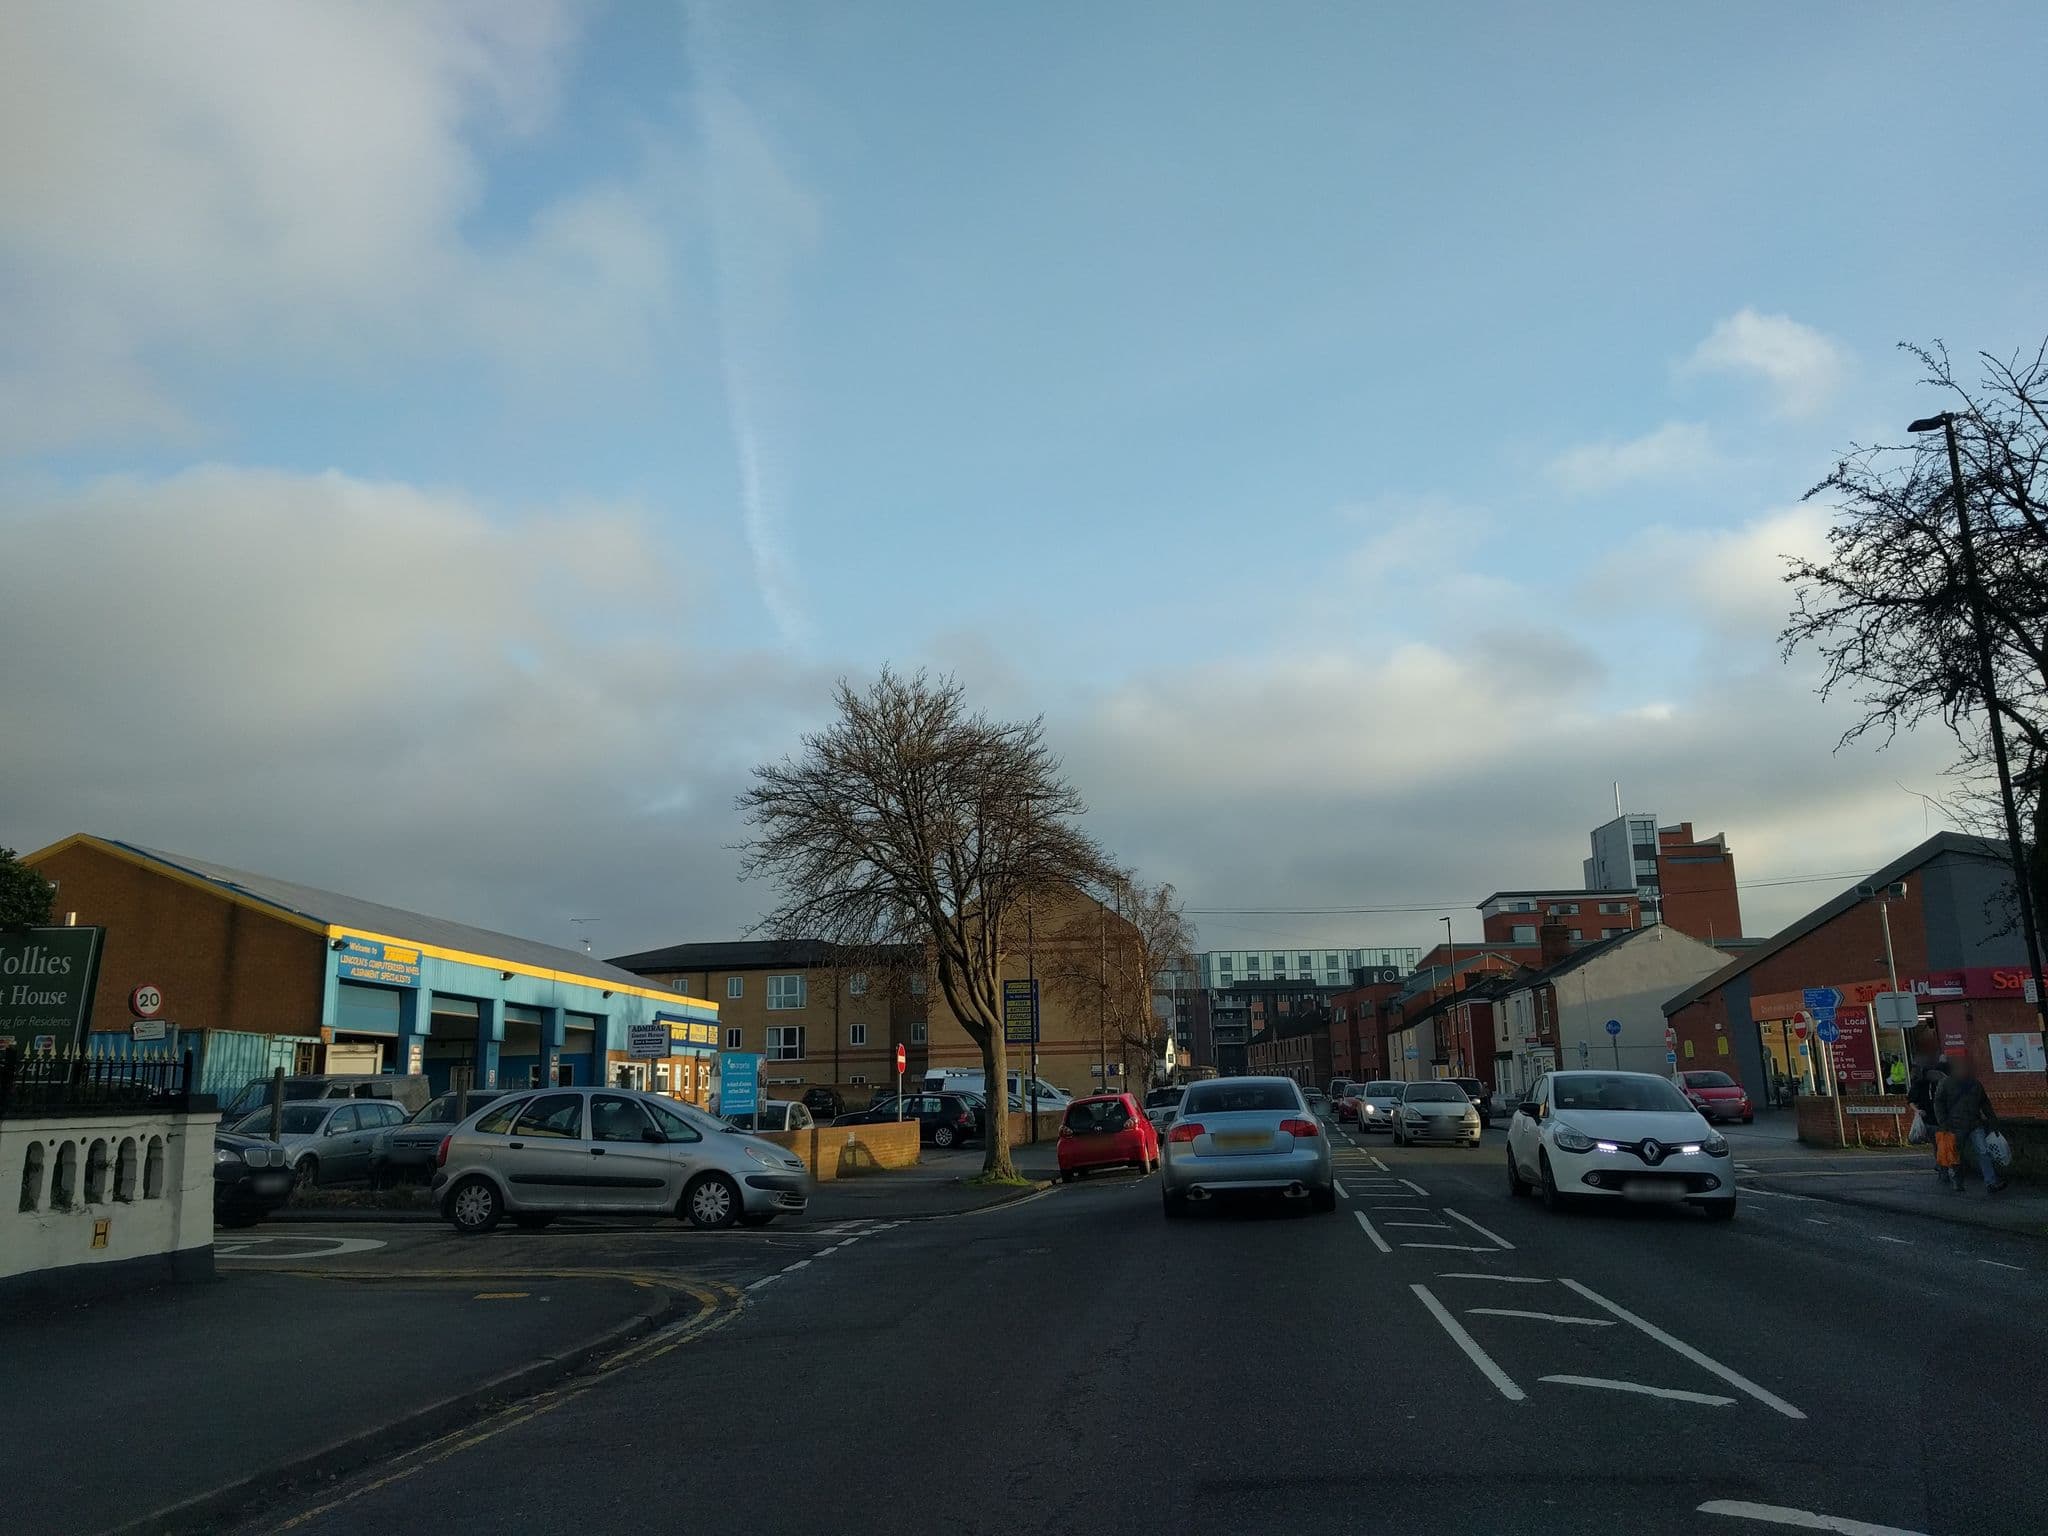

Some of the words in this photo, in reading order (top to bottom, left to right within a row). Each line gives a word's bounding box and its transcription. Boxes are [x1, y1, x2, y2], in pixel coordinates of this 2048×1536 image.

[0, 946, 71, 975] ollies
[11, 985, 68, 1005] House
[139, 993, 160, 1007] 20
[29, 1016, 71, 1026] Residents
[1844, 1018, 1867, 1026] Local
[92, 1222, 109, 1247] H
